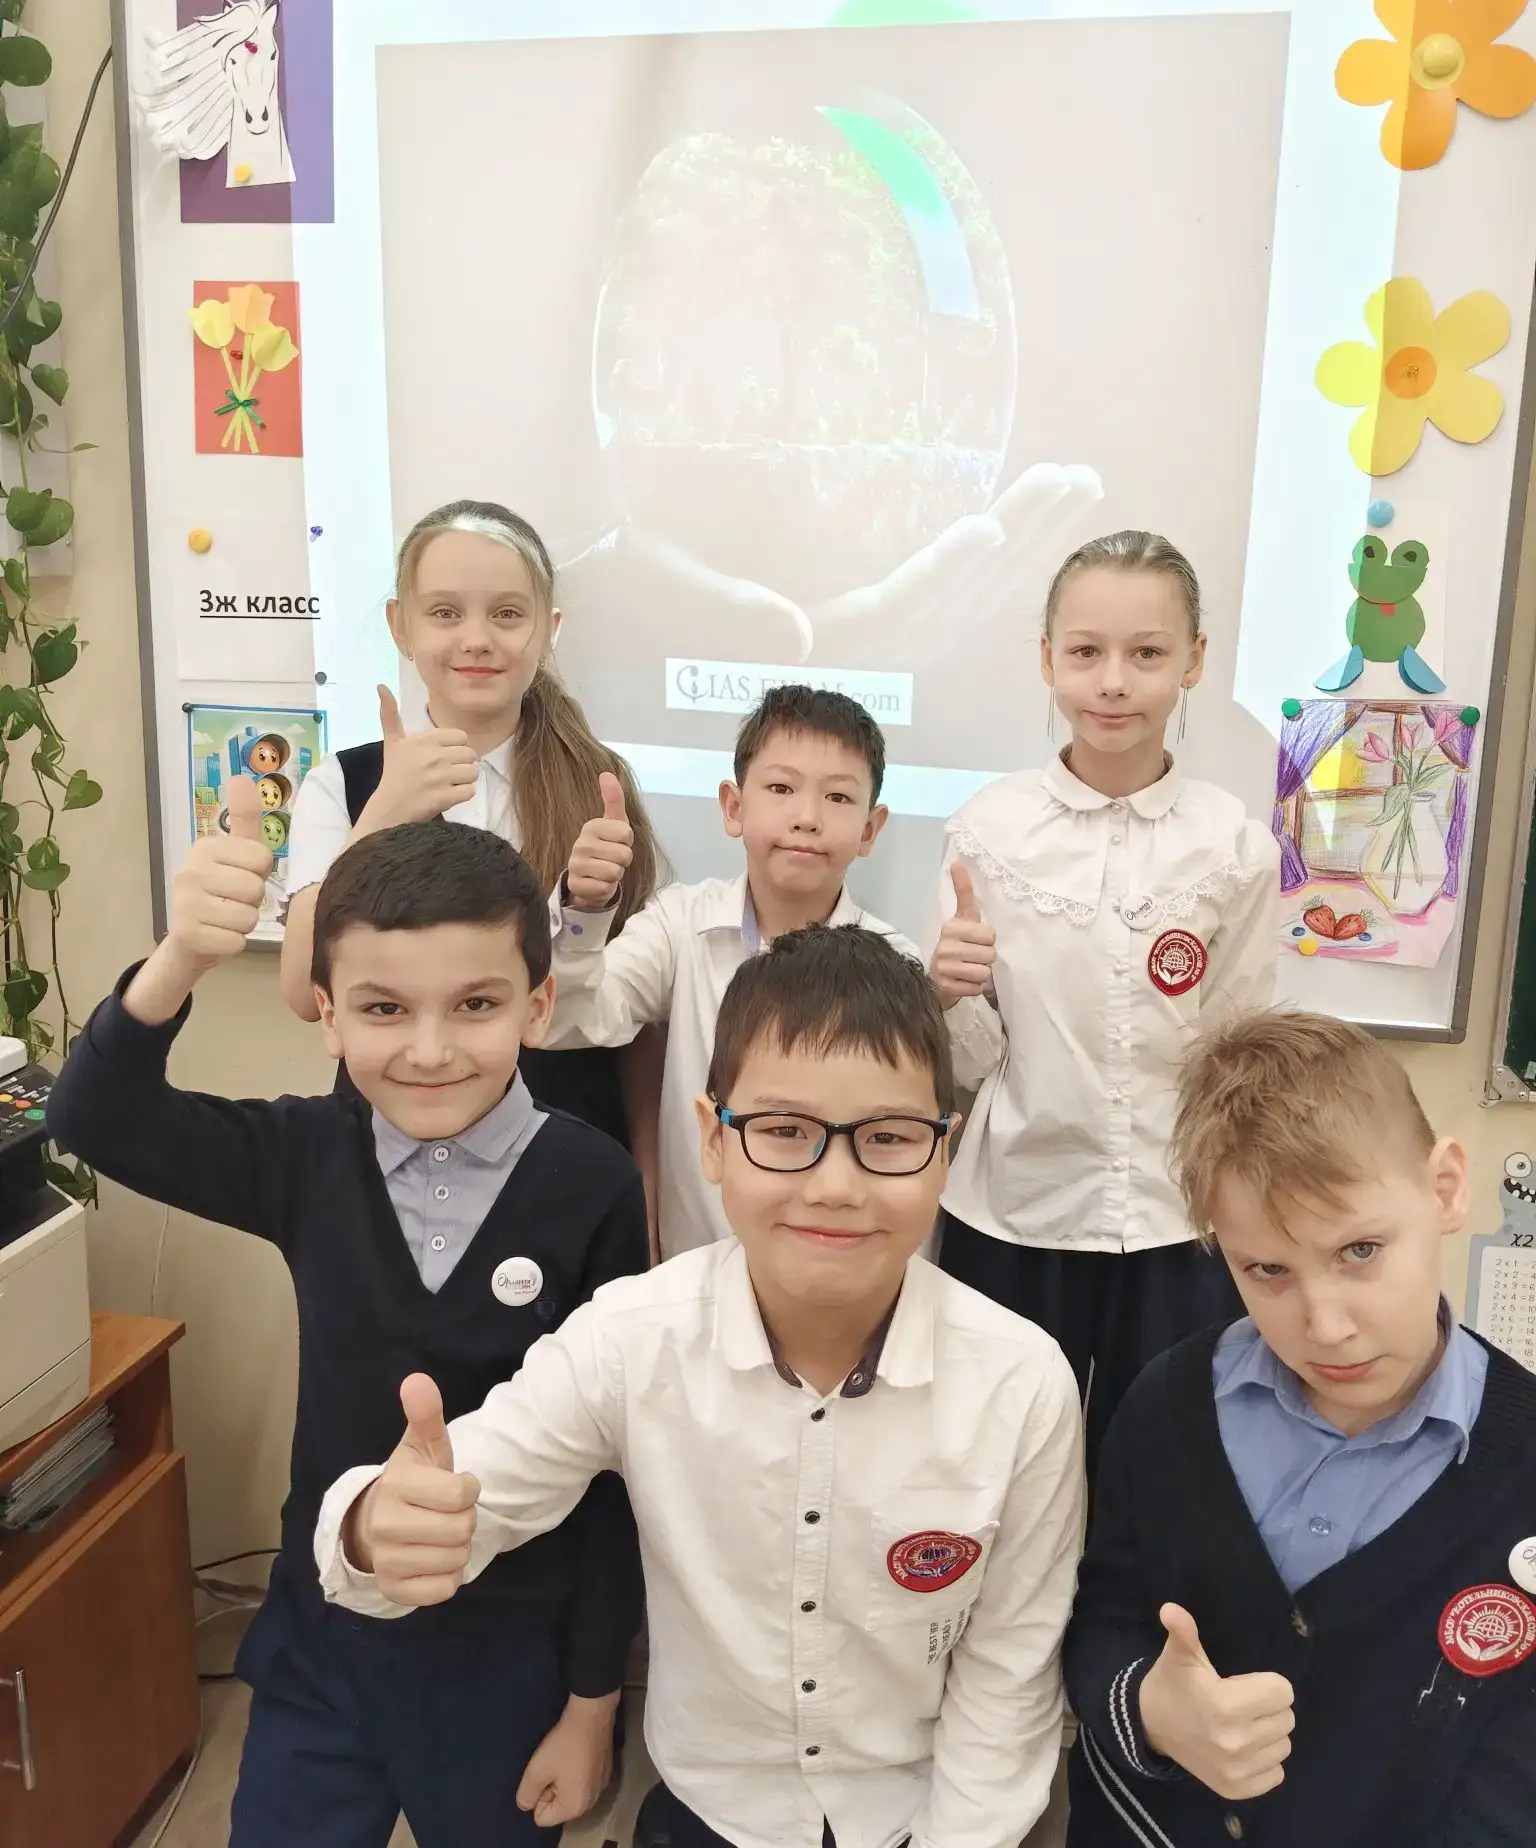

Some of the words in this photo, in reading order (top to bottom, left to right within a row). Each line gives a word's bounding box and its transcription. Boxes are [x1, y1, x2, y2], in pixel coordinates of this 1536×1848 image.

[200, 590, 237, 613] 3ж
[247, 596, 319, 614] класс
[708, 674, 751, 701] IAS
